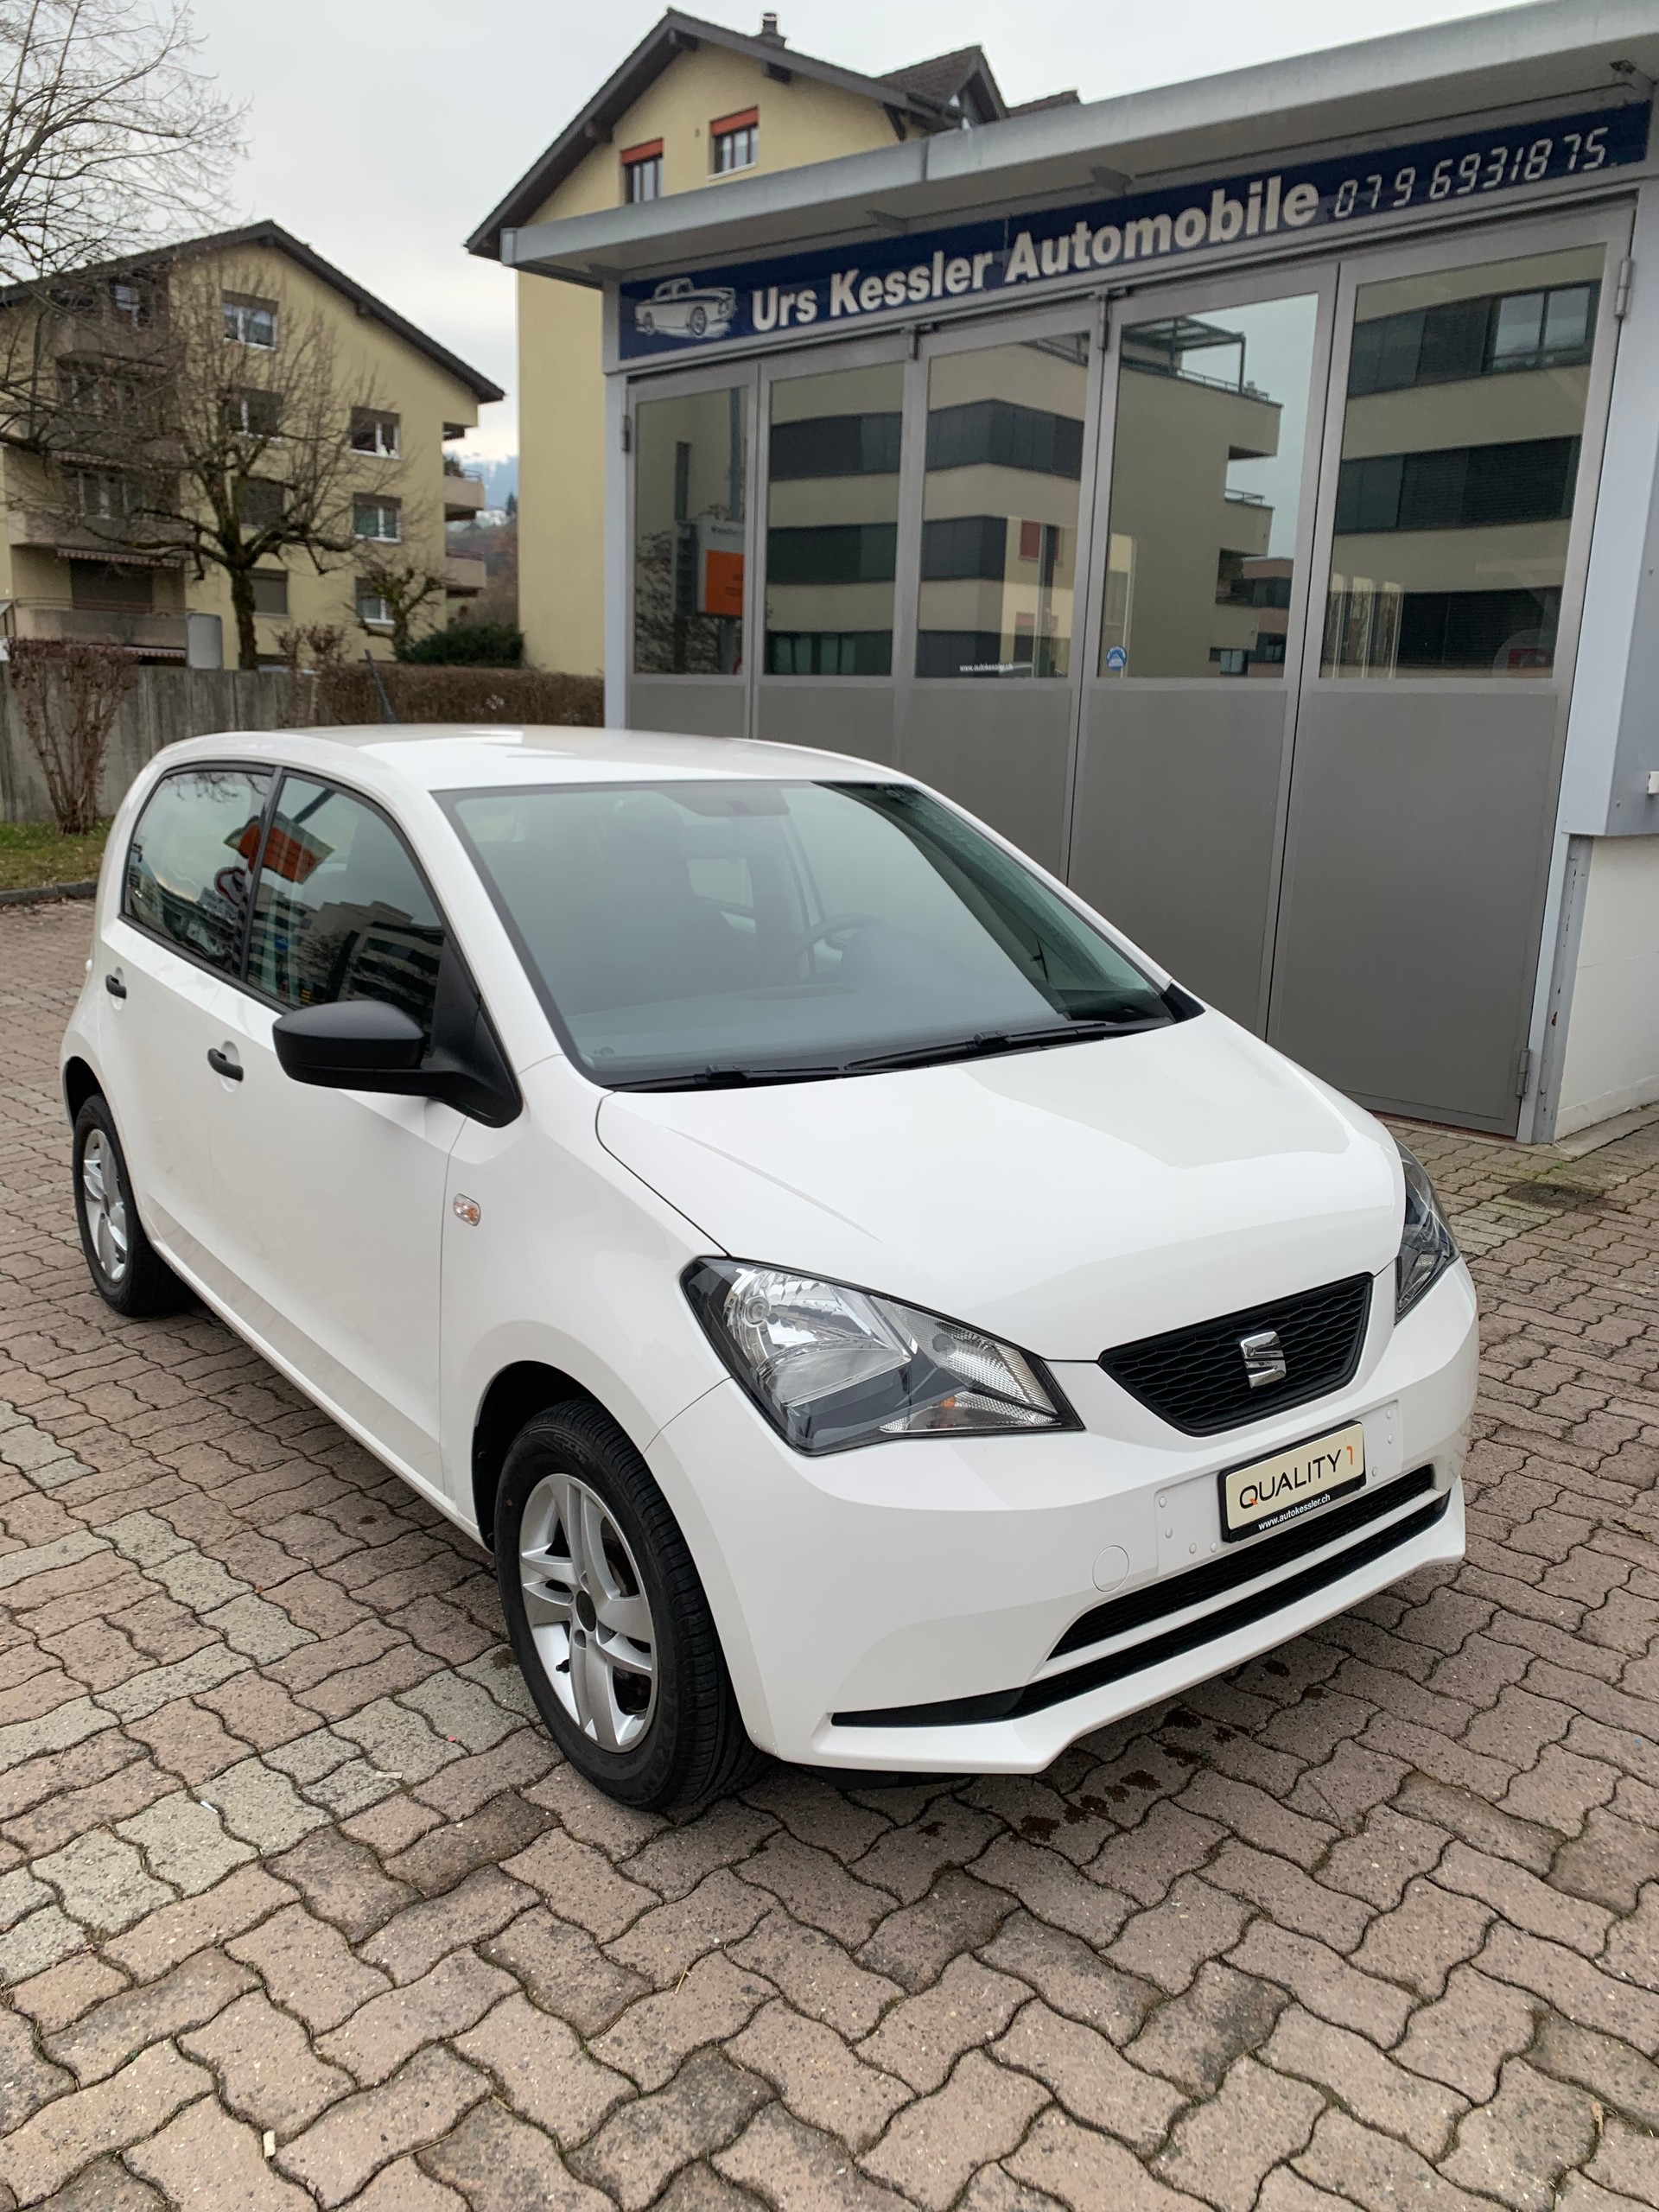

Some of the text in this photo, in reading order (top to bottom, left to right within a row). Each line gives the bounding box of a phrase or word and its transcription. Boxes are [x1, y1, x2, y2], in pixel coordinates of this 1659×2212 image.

[752, 175, 1319, 332] Urs Kessler Automobile
[1239, 1449, 1342, 1510] QUALITY
[1258, 1493, 1331, 1531] www.autokessler.ch
